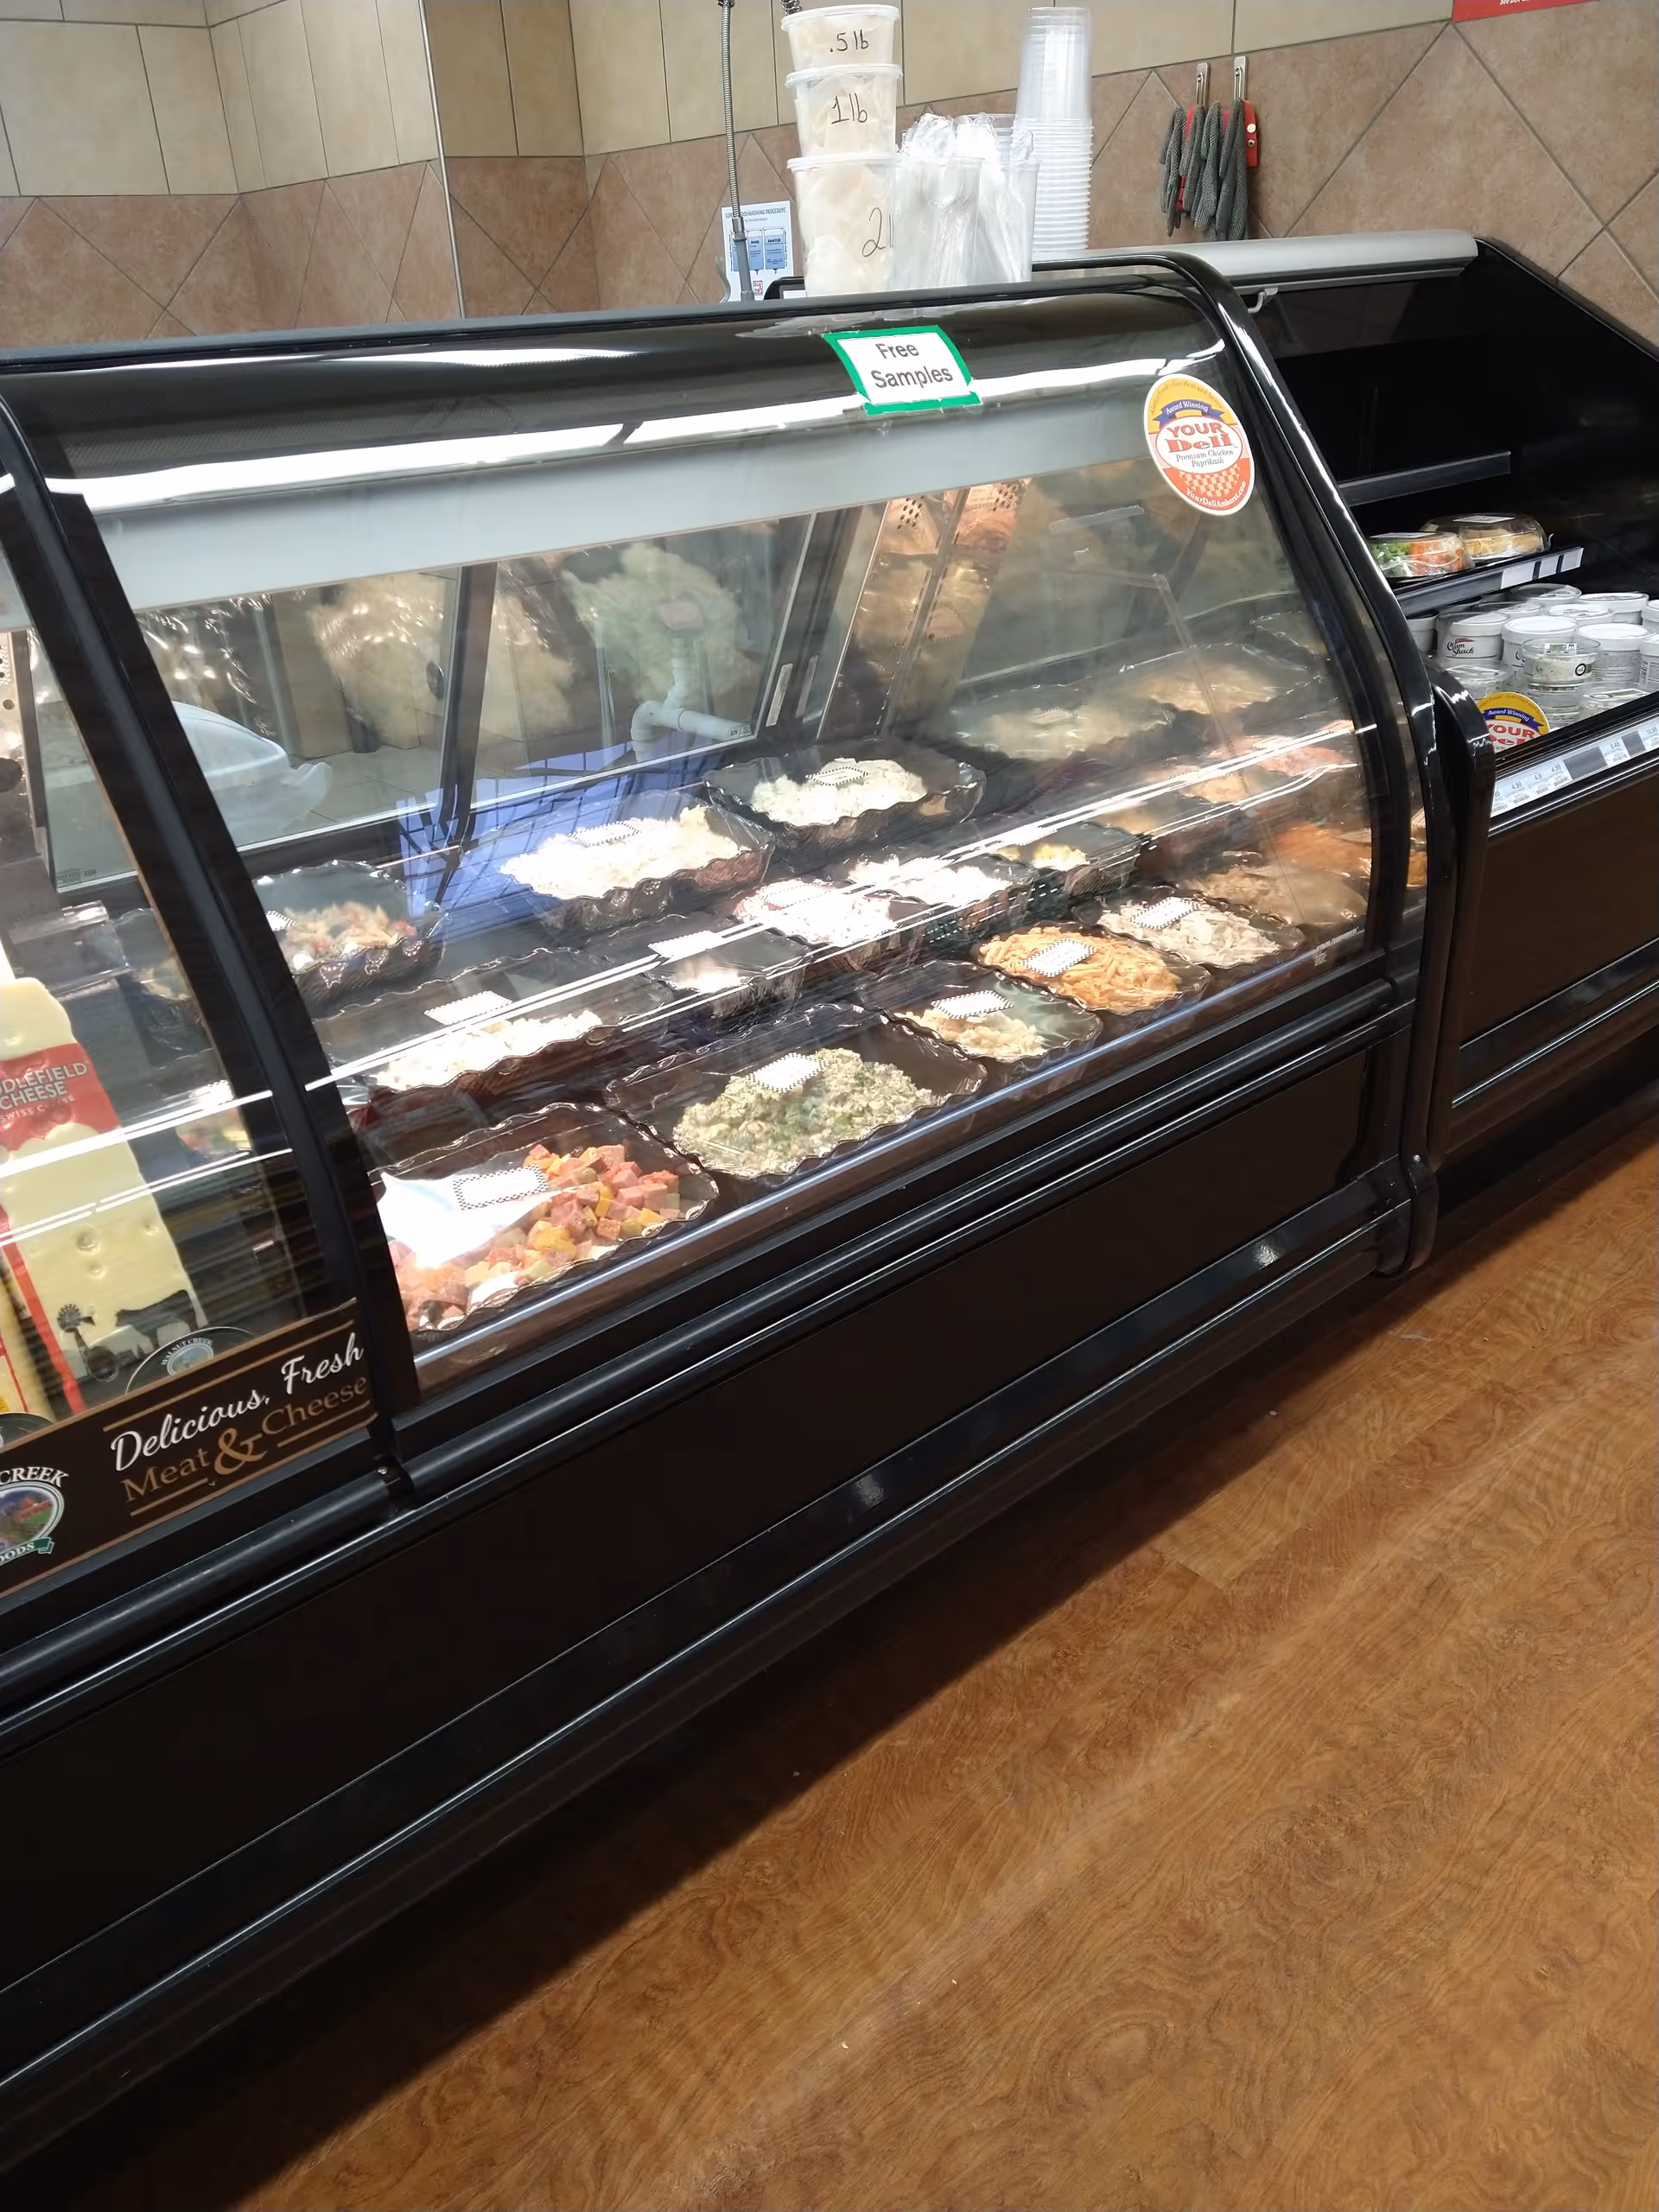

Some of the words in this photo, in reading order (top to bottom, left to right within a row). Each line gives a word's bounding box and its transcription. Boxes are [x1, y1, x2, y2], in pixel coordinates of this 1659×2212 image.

[830, 32, 848, 52] .5
[830, 95, 850, 124] 1
[875, 343, 919, 359] Free
[871, 365, 954, 388] Samples
[1166, 402, 1183, 415] Award
[1182, 400, 1209, 412] Winning
[1166, 423, 1226, 438] YOUR
[1164, 433, 1234, 453] Deli
[1176, 452, 1207, 462] Premium
[1207, 448, 1234, 457] Chicken
[1192, 456, 1224, 467] Paprikash
[1452, 647, 1475, 657] Shack
[1507, 709, 1530, 722] Winning
[0, 1062, 88, 1095] DLEFIELD
[0, 1080, 67, 1110] CHEESE
[111, 1389, 270, 1471] Delicious,
[281, 1332, 365, 1395] Fresh
[120, 1447, 211, 1503] Meat
[213, 1427, 268, 1476] &
[262, 1376, 367, 1436] Cheese
[0, 1466, 69, 1488] CREEK
